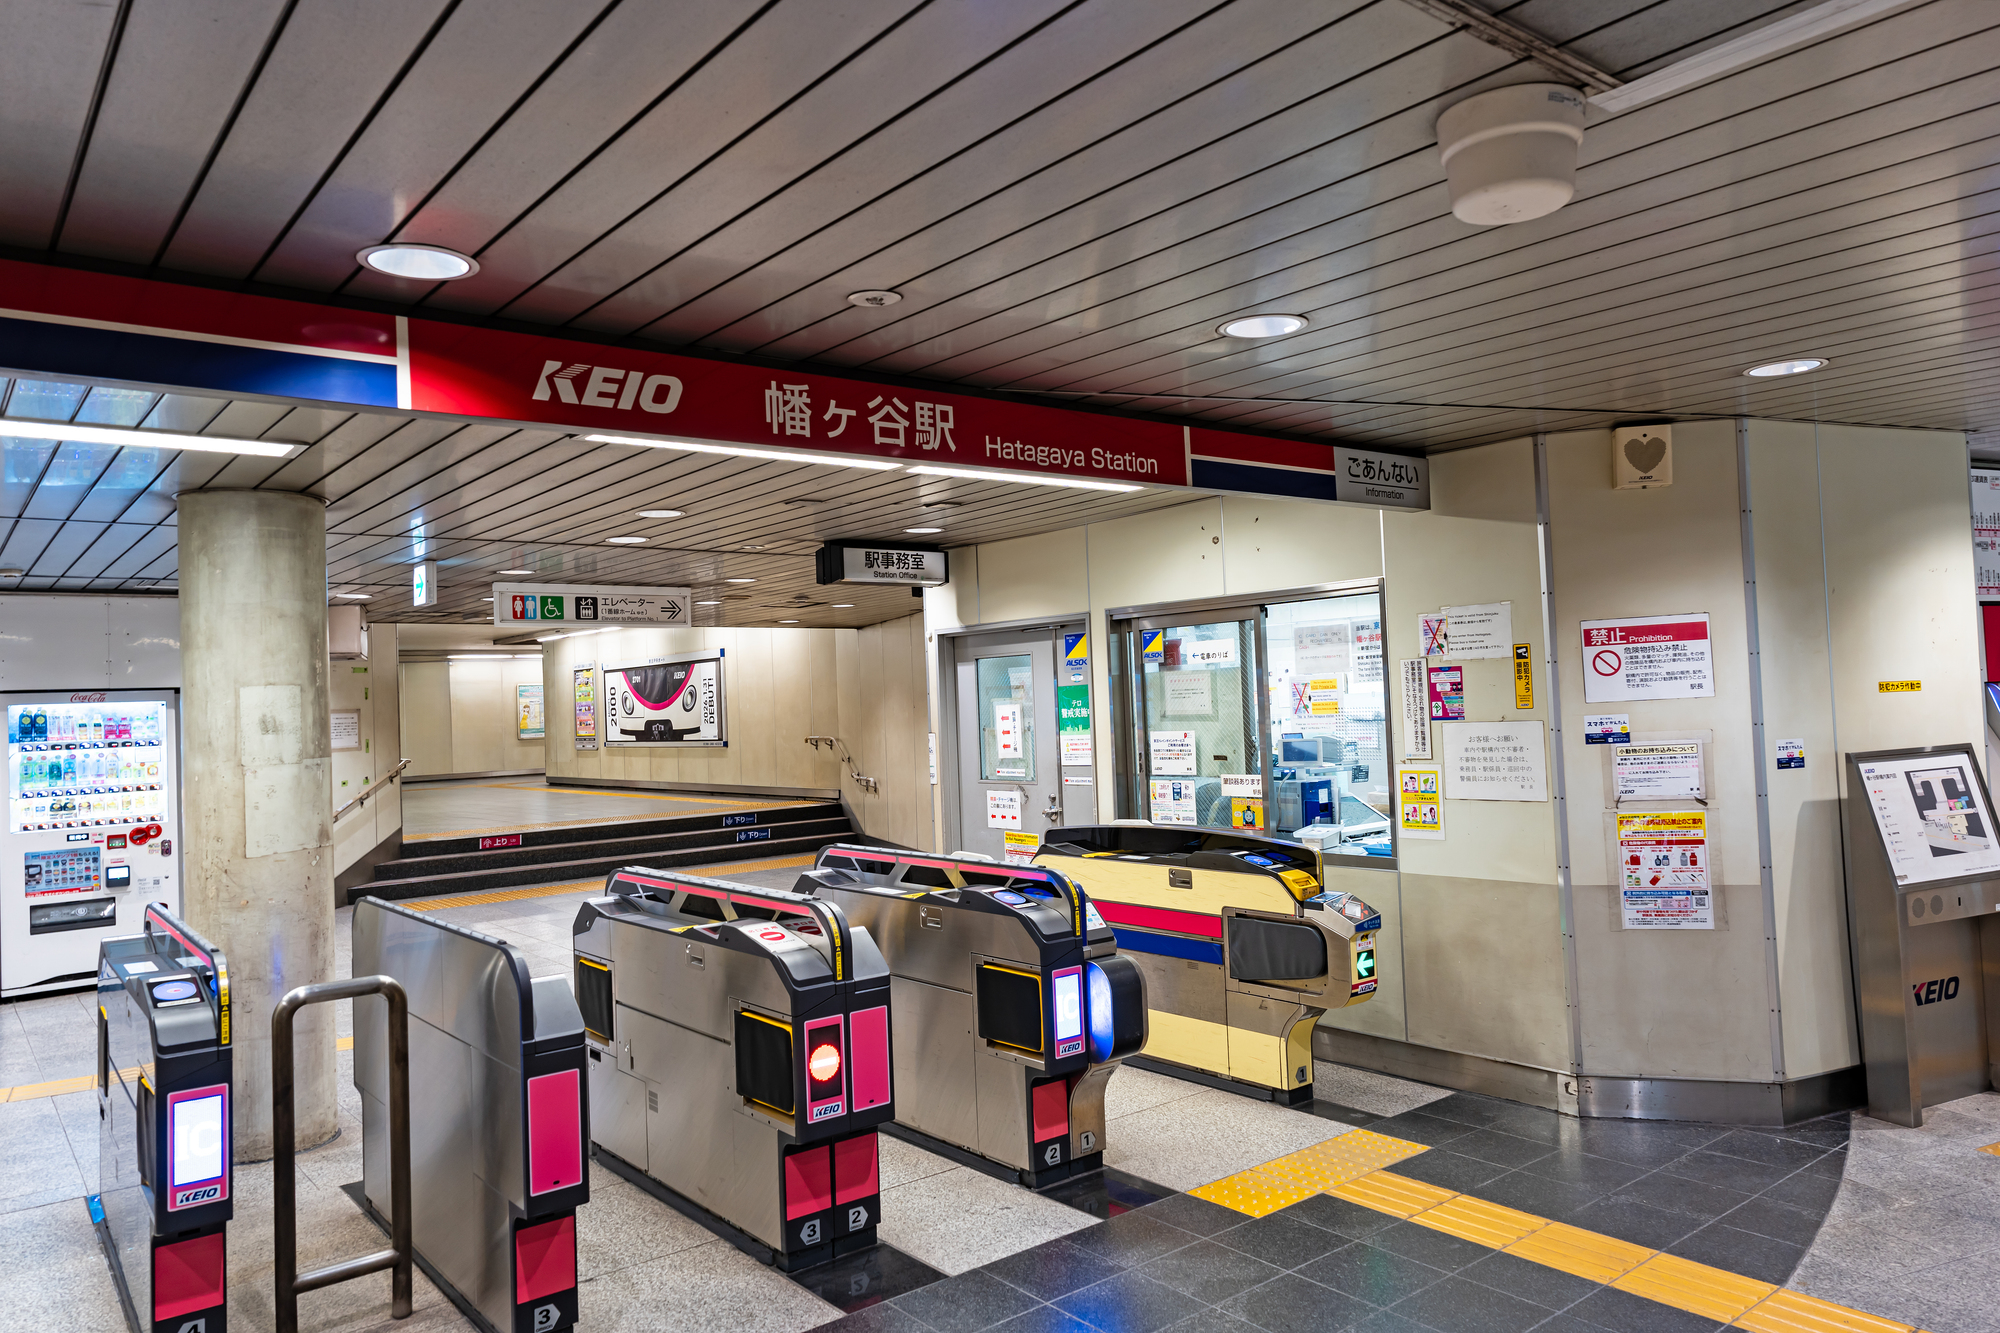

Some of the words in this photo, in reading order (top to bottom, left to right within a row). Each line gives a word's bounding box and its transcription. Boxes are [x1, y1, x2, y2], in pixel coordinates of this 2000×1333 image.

[532, 360, 683, 414] KEIO
[764, 380, 957, 452] 幡ヶ谷駅
[985, 436, 1085, 467] Hatagaya
[1091, 447, 1158, 474] Station
[1348, 457, 1419, 484] ごあんない
[1365, 487, 1404, 500] Information
[864, 551, 925, 570] 駅事務室
[873, 571, 897, 579] Station
[898, 572, 918, 580] Office
[601, 597, 655, 607] エレベーター
[1590, 628, 1627, 646] 禁止
[1629, 634, 1673, 643] Prohibition
[1144, 651, 1162, 659] ALSOK
[1200, 651, 1229, 660] 電車のりば
[1623, 644, 1688, 655] 危険物持込み禁止
[1066, 658, 1087, 666] ALSOK
[673, 671, 686, 679] KEIO
[610, 687, 618, 727] 2000
[708, 678, 716, 724] DEBUT!
[1468, 735, 1518, 743] お客様へお願い
[1619, 746, 1695, 754] 小動物のお持ち込みについて
[1223, 777, 1261, 785] 筆談器あります
[733, 816, 746, 824] 下り
[747, 831, 759, 839] 下り
[494, 838, 507, 846] 上り
[1359, 984, 1374, 992] KEIO
[1912, 976, 1960, 1006] KEIO
[1057, 992, 1079, 1022] IC
[1061, 1042, 1080, 1054] KEIO
[1300, 1068, 1305, 1078] 1
[815, 1104, 840, 1118] KEIO
[176, 1120, 220, 1161] IC
[1084, 1134, 1089, 1146] 1
[1050, 1147, 1058, 1159] 2
[179, 1187, 218, 1204] KEIO
[851, 1210, 861, 1224] 2
[806, 1223, 817, 1238] 3
[538, 1308, 551, 1325] 3
